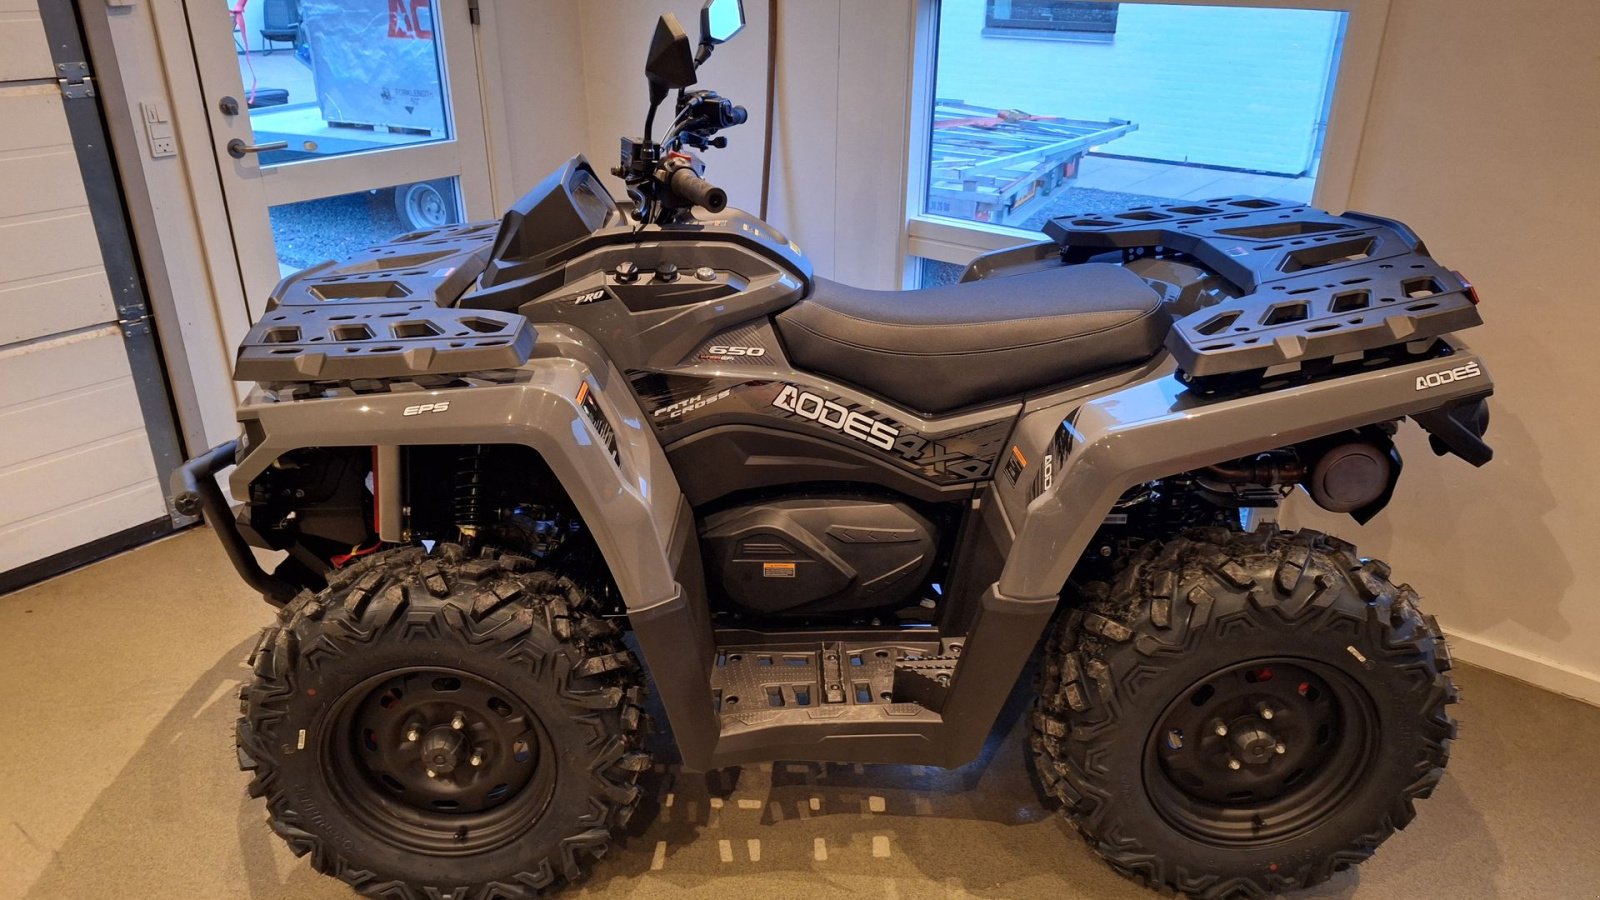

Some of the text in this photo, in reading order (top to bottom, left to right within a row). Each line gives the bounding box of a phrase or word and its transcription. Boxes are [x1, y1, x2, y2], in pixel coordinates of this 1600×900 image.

[575, 290, 605, 305] PRO
[709, 345, 765, 357] 650
[1416, 361, 1481, 391] AODES
[403, 401, 450, 416] EPS
[772, 384, 900, 451] AODES
